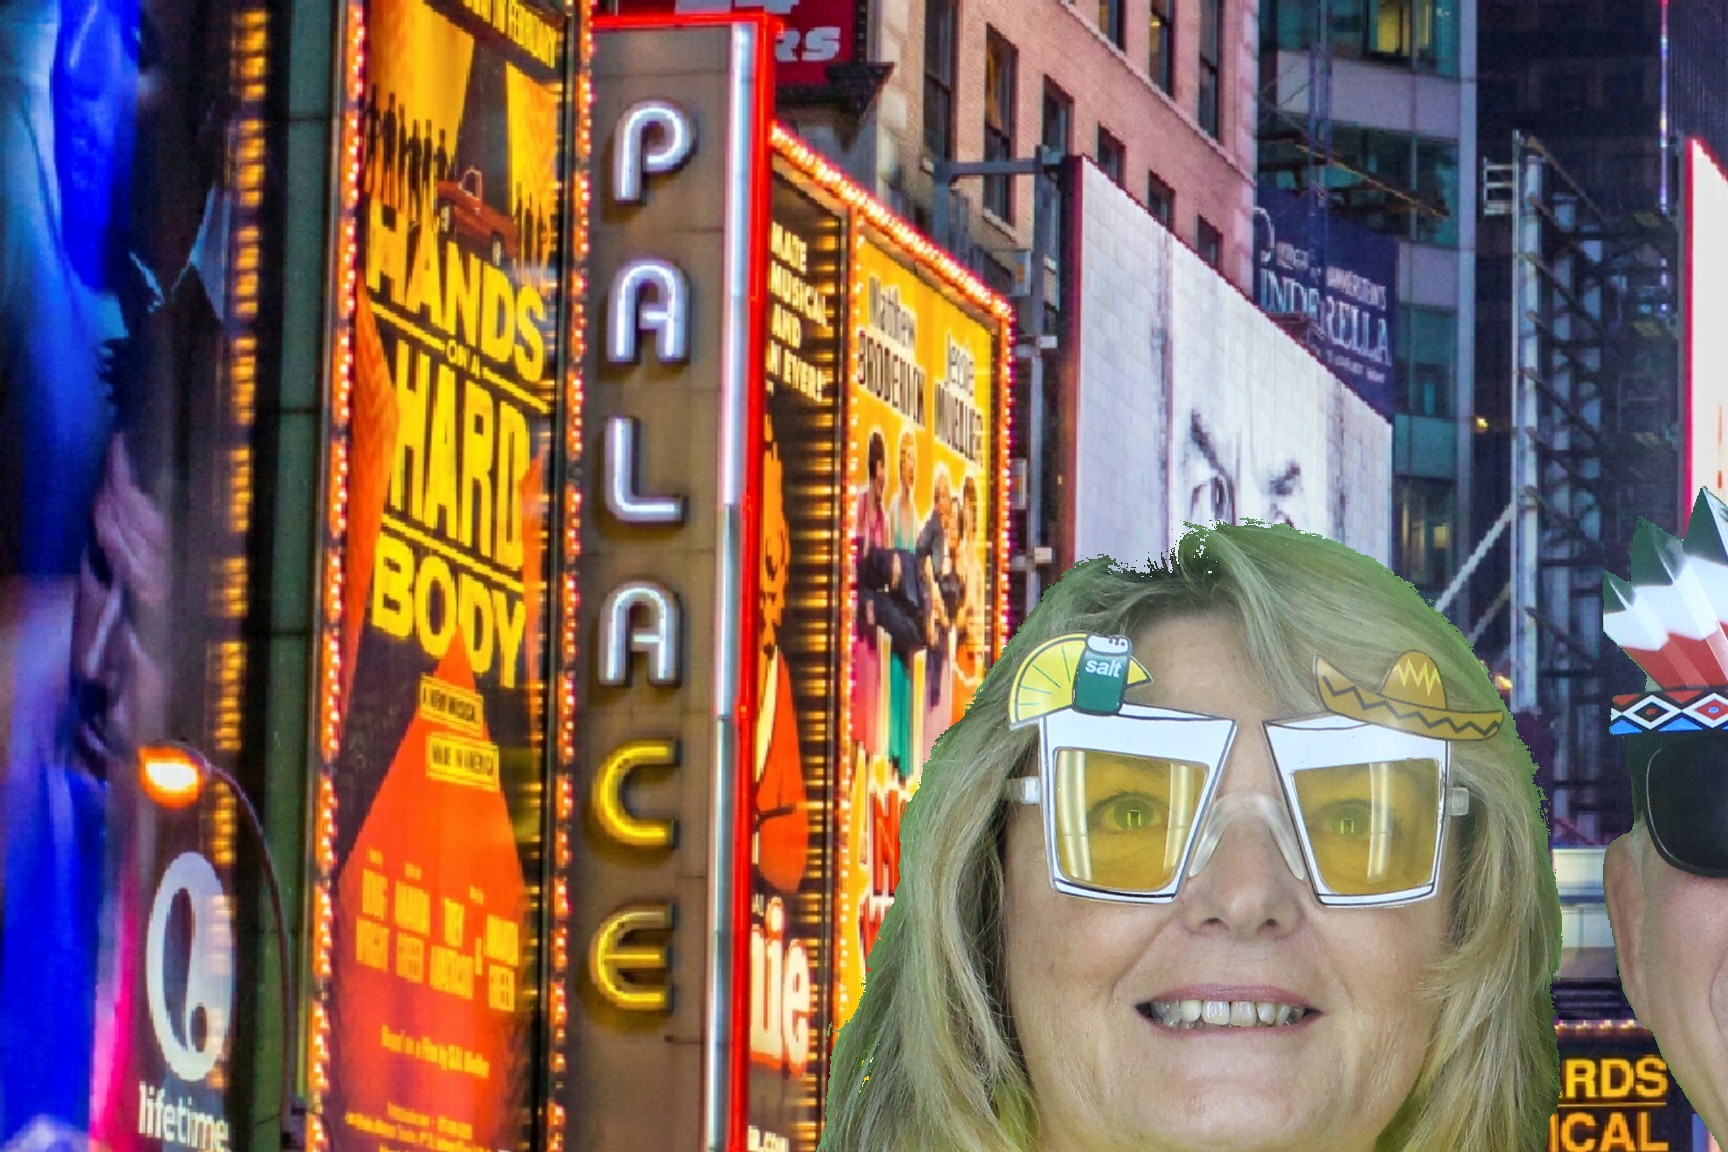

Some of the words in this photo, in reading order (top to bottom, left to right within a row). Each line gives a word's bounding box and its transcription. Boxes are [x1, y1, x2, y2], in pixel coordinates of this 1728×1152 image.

[366, 194, 545, 383] HANDS
[771, 221, 807, 275] MATE
[390, 338, 530, 571] HARD
[372, 530, 526, 689] BODY
[591, 101, 693, 1011] PALACE
[1085, 659, 1122, 678] salt
[1560, 1055, 1668, 1099] RDS
